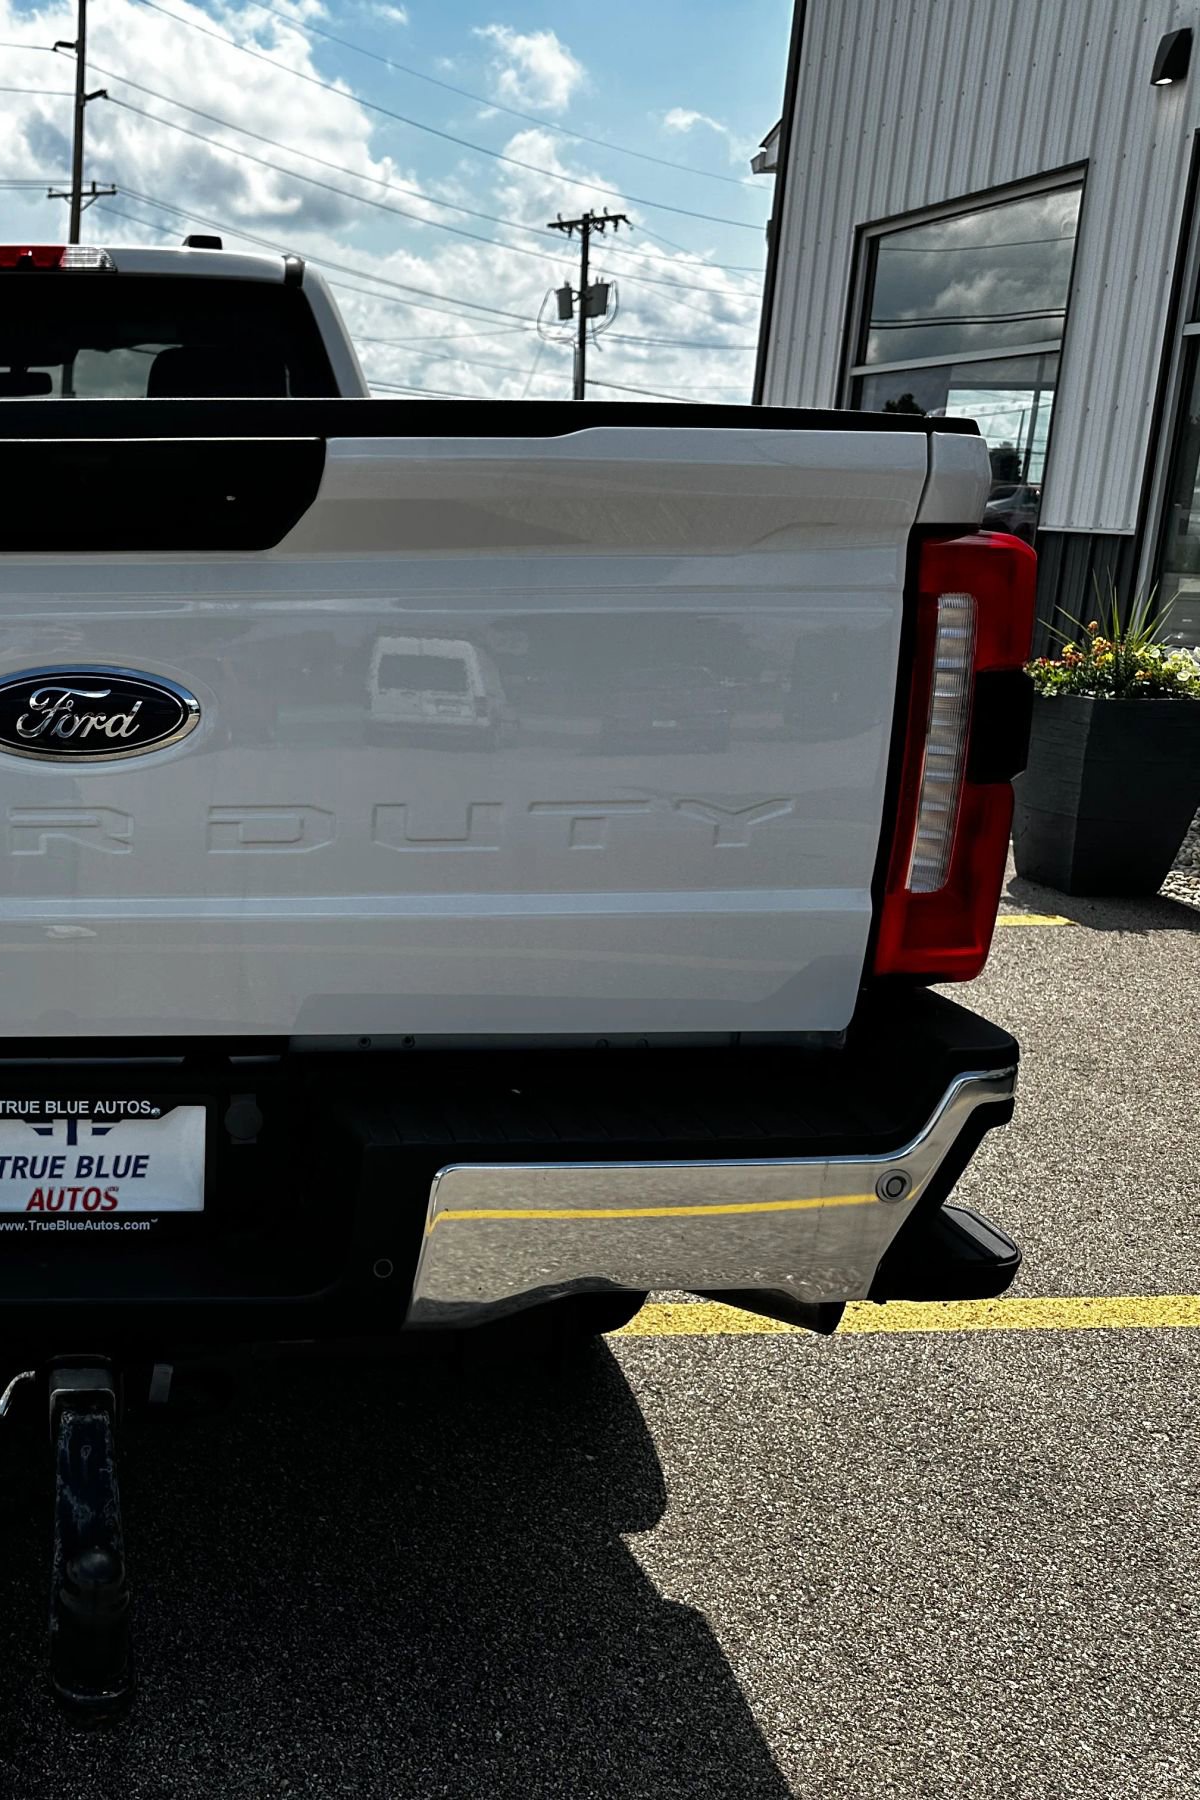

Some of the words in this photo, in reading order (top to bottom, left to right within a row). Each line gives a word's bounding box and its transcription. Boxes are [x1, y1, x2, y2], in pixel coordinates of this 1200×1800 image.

[16, 686, 144, 738] Ford
[207, 798, 794, 855] DUTY
[45, 1100, 90, 1114] BLUE
[94, 1100, 151, 1114] AUTOS
[75, 1155, 150, 1179] BLUE
[26, 1187, 119, 1211] AUTOS
